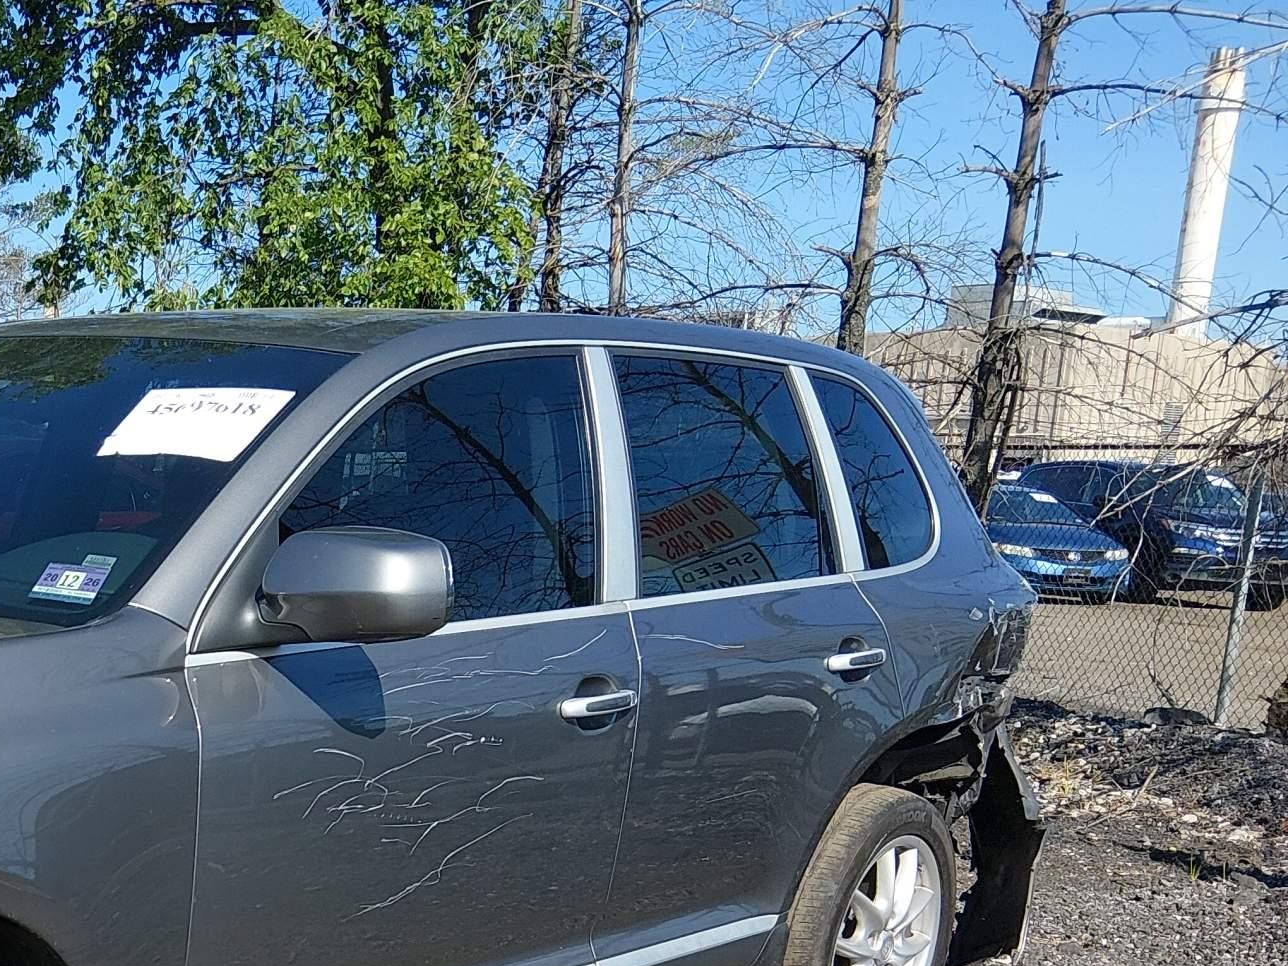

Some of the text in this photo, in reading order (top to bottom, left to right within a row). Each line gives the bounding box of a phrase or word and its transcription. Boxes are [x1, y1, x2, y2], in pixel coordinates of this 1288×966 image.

[43, 573, 59, 582] 20
[59, 575, 80, 587] 12
[84, 578, 101, 587] 26
